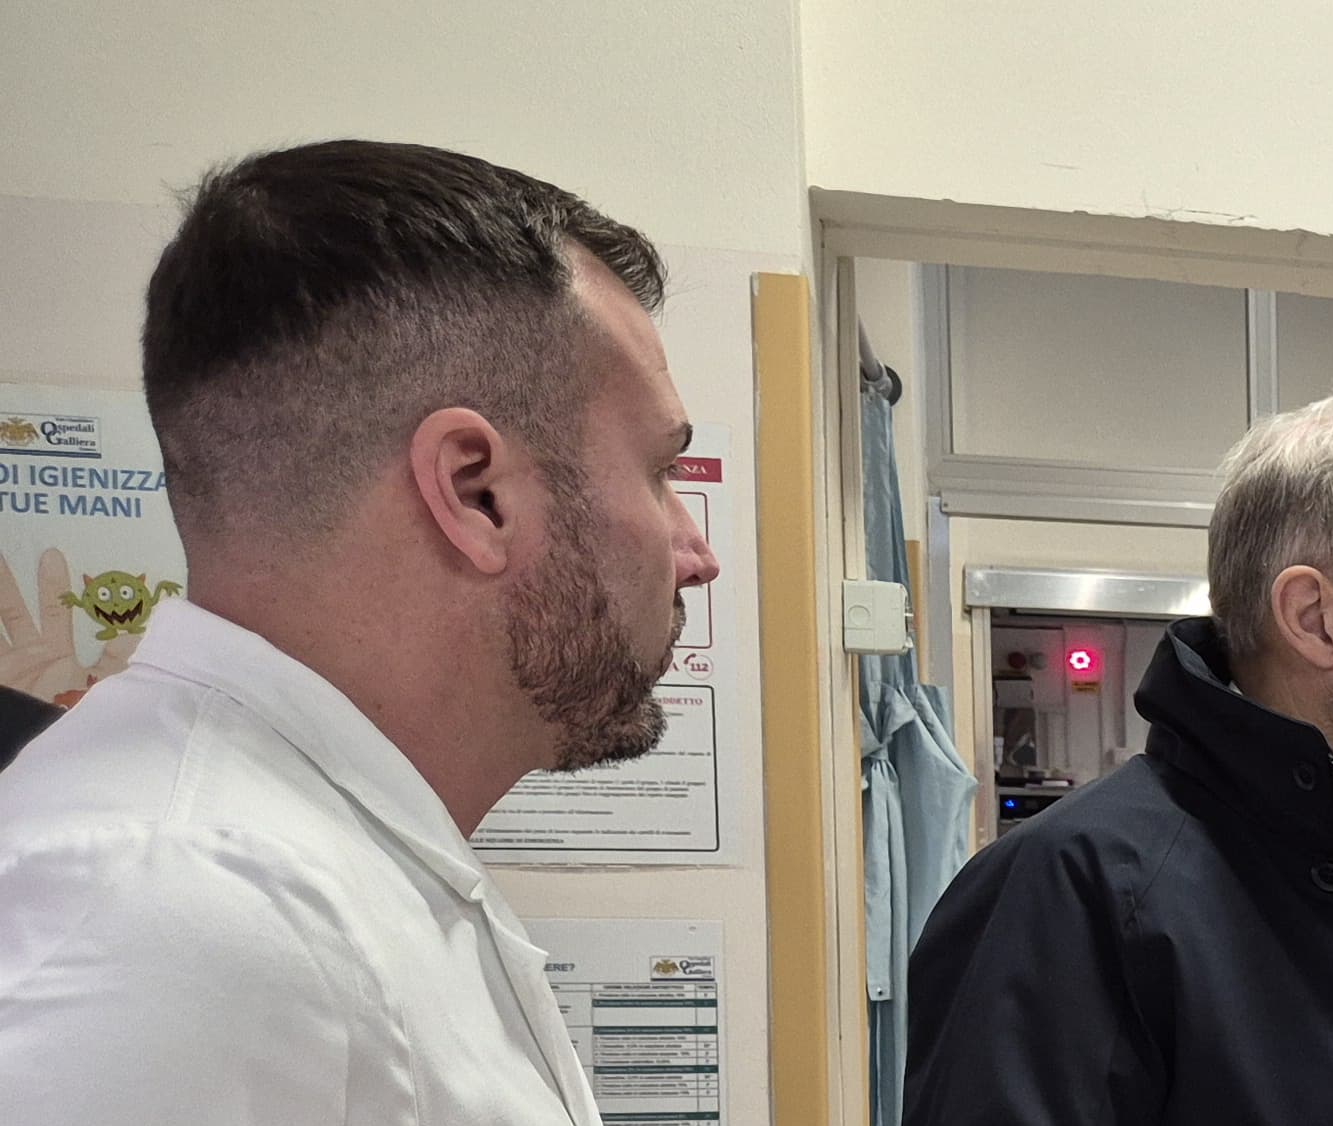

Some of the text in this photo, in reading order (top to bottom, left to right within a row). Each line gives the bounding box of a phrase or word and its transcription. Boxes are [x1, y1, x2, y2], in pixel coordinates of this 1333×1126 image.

[41, 421, 95, 437] Ospedali
[58, 494, 142, 518] MANI
[690, 663, 709, 672] 112
